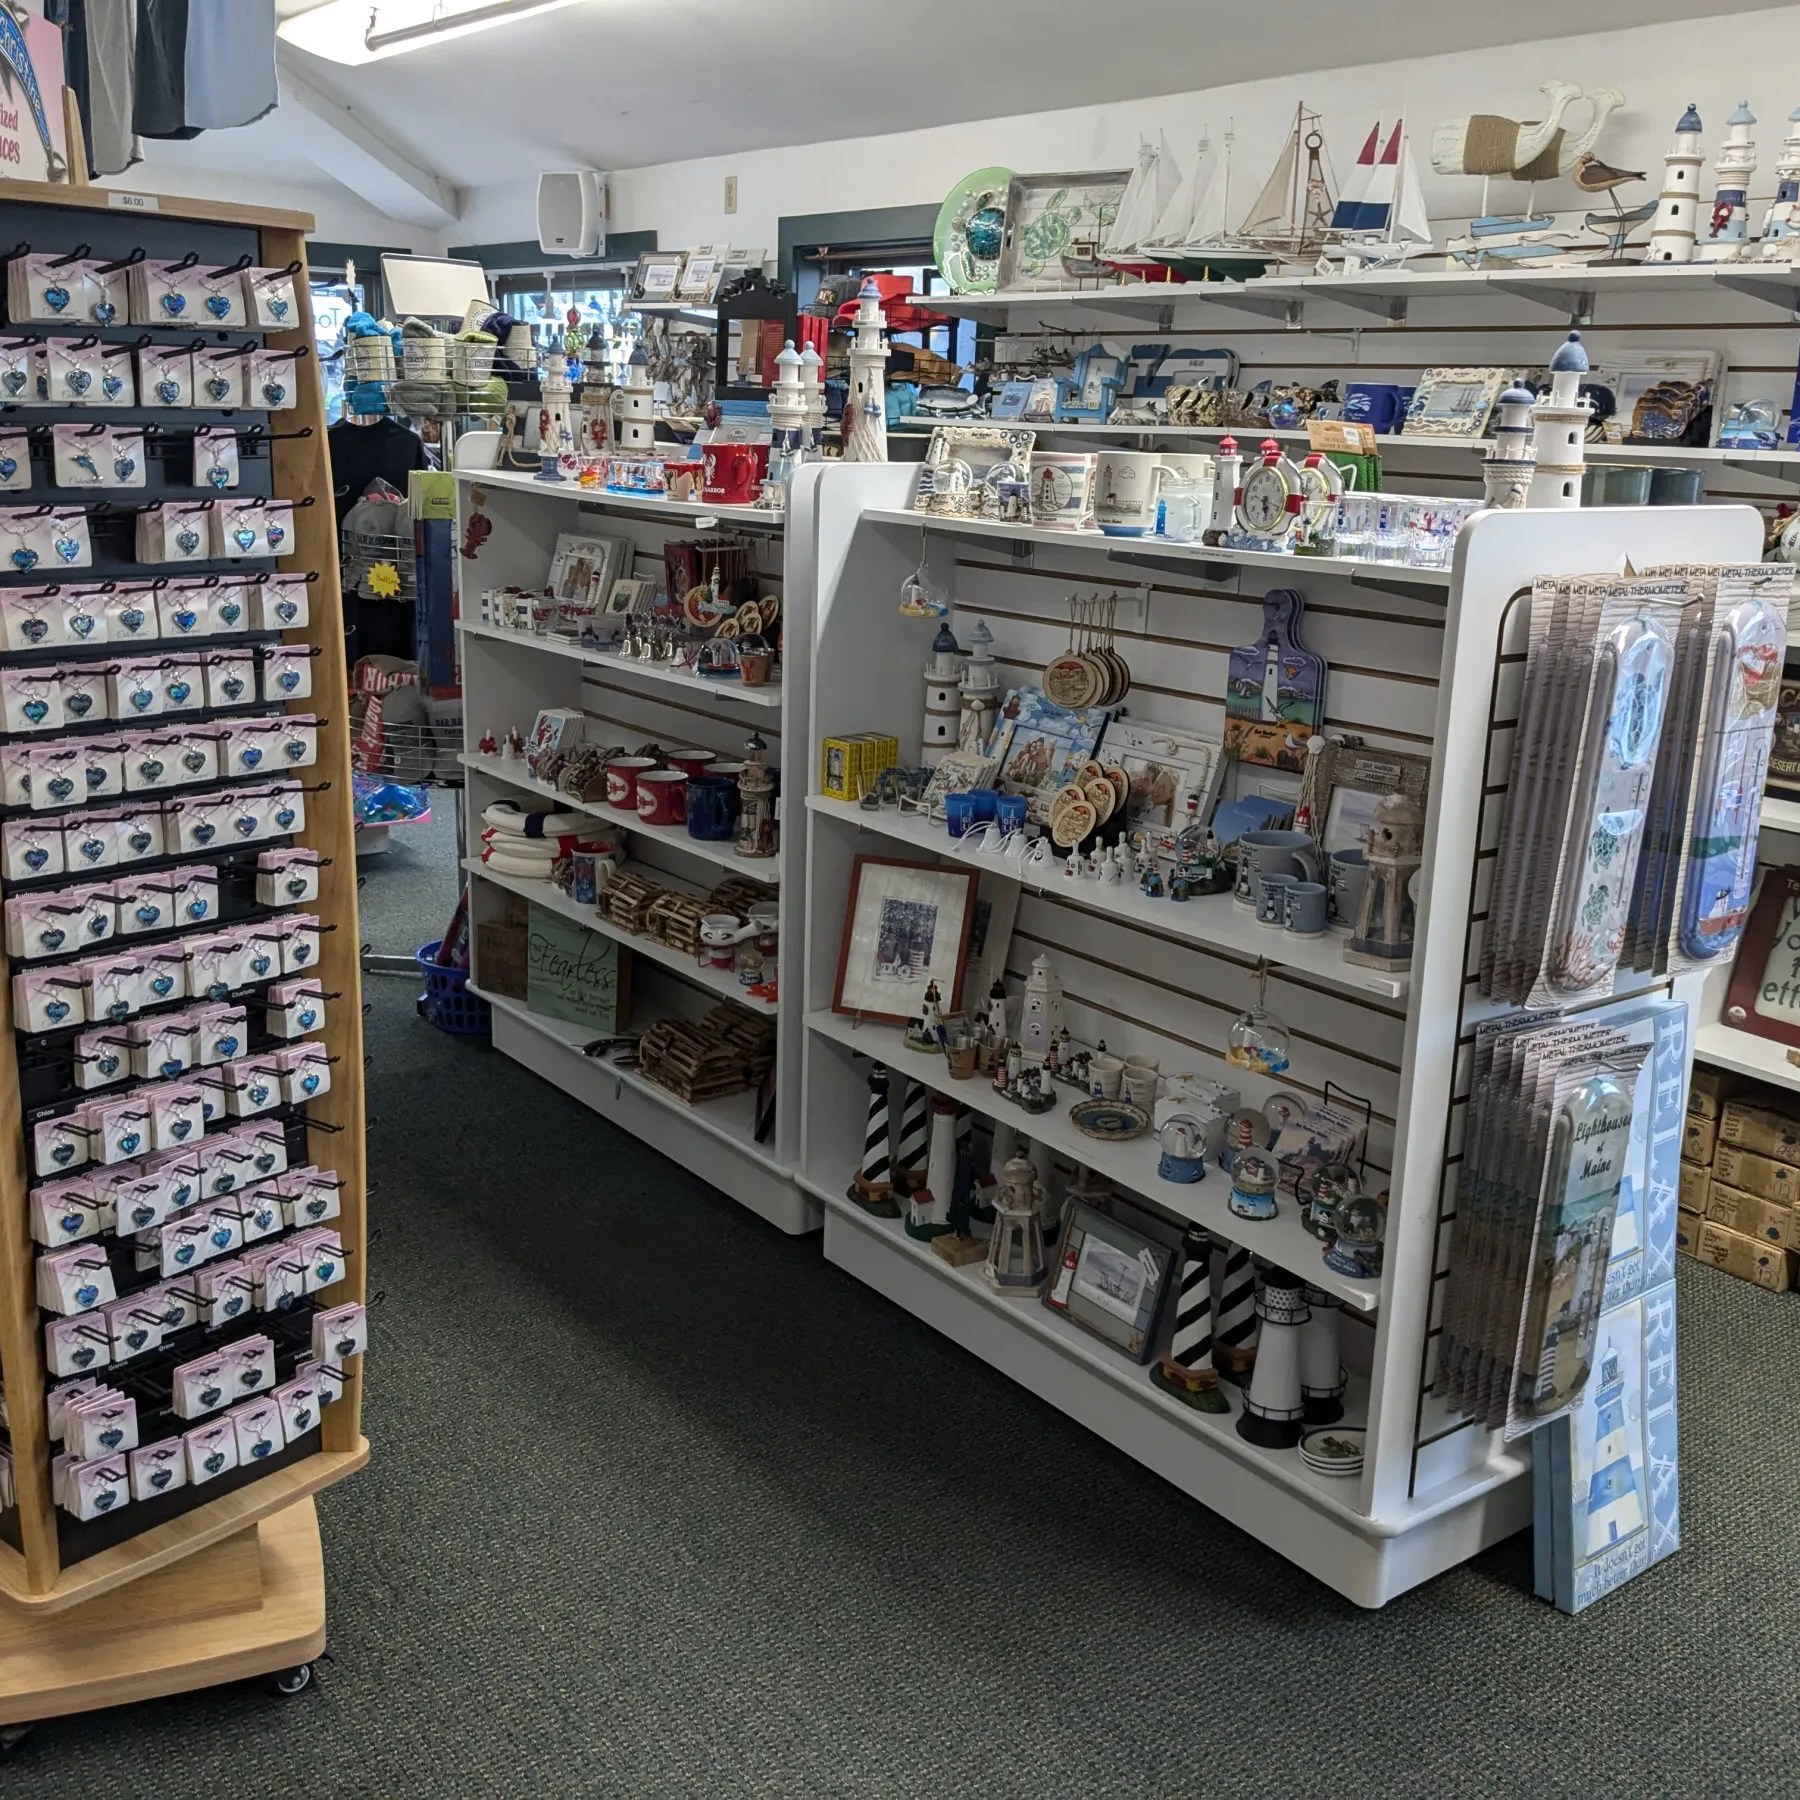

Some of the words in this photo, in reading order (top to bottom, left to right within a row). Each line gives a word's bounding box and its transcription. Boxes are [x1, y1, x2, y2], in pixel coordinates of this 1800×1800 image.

[0, 138, 20, 165] ces
[122, 196, 144, 207] $6.00
[1630, 584, 1686, 596] THERMOMETER
[1003, 818, 1020, 826] GET
[529, 932, 616, 991] Fearless
[231, 988, 256, 998] Charlotte
[1504, 1009, 1562, 1029] THERMOMETER
[1568, 1036, 1628, 1053] THERMOMETER
[36, 1109, 55, 1118] Chloe
[1573, 1113, 1632, 1146] Lighthouses
[1648, 1019, 1684, 1274] RELAX
[1579, 1159, 1612, 1181] Maine
[1644, 1298, 1678, 1552] RELAX
[1577, 1581, 1602, 1606] much
